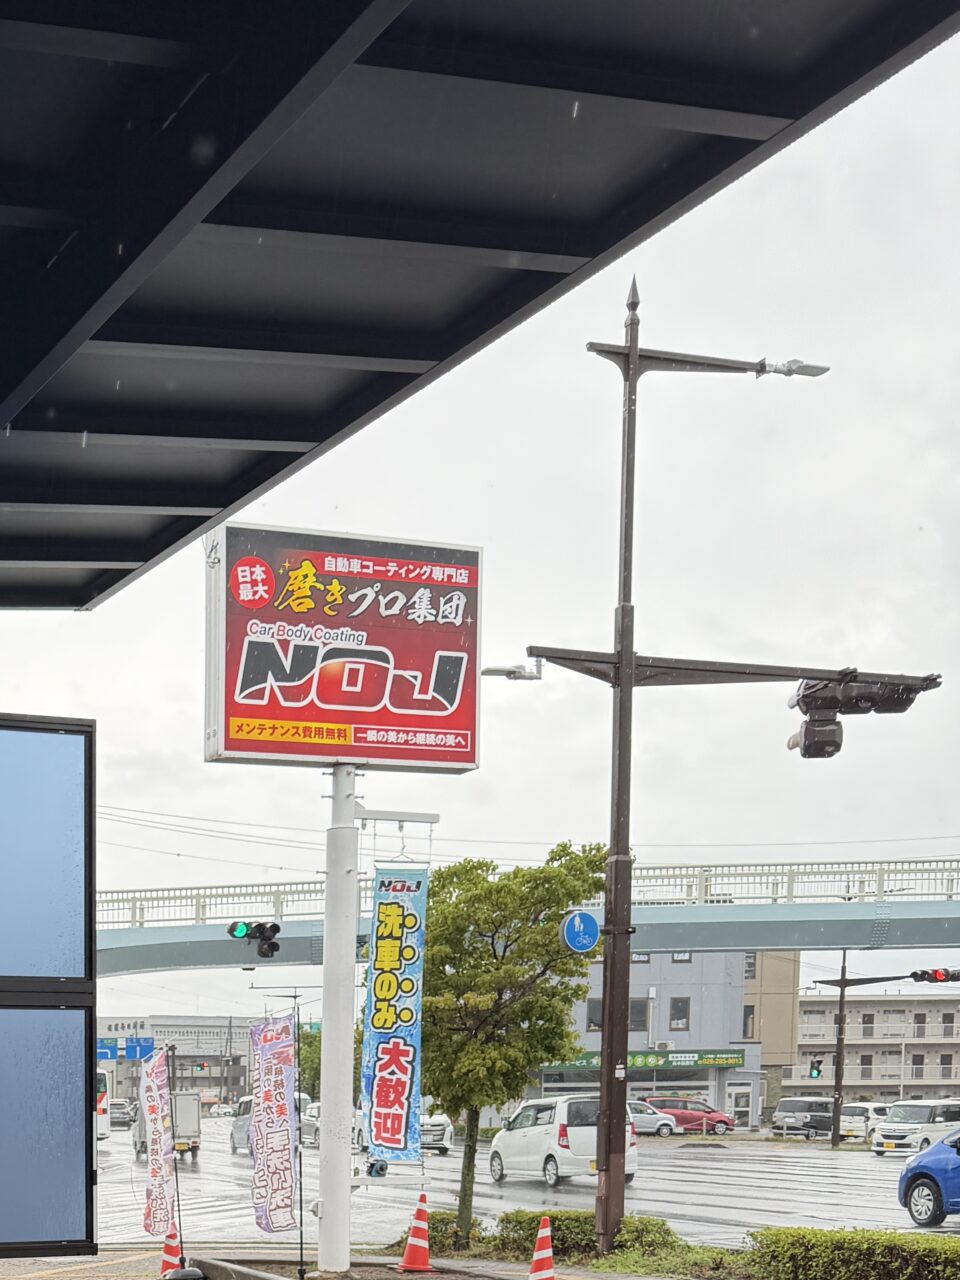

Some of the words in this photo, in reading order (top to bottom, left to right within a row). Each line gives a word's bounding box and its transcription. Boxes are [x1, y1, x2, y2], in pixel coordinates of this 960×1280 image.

[237, 564, 267, 582] 日本
[324, 556, 470, 584] 自動車コーティング専門店
[238, 584, 269, 601] 最大
[274, 559, 468, 627] 磨きプロ集団
[249, 620, 274, 636] Car
[276, 623, 311, 640] Body
[313, 627, 365, 646] Coating
[234, 636, 468, 716] NOJ
[235, 722, 348, 741] メンテナンス費用無料
[356, 730, 467, 748] 一瞬の美から継続の美へ
[378, 880, 423, 893] NOJ
[372, 901, 406, 1029] 洗車のみ
[373, 1040, 412, 1147] 大歓迎
